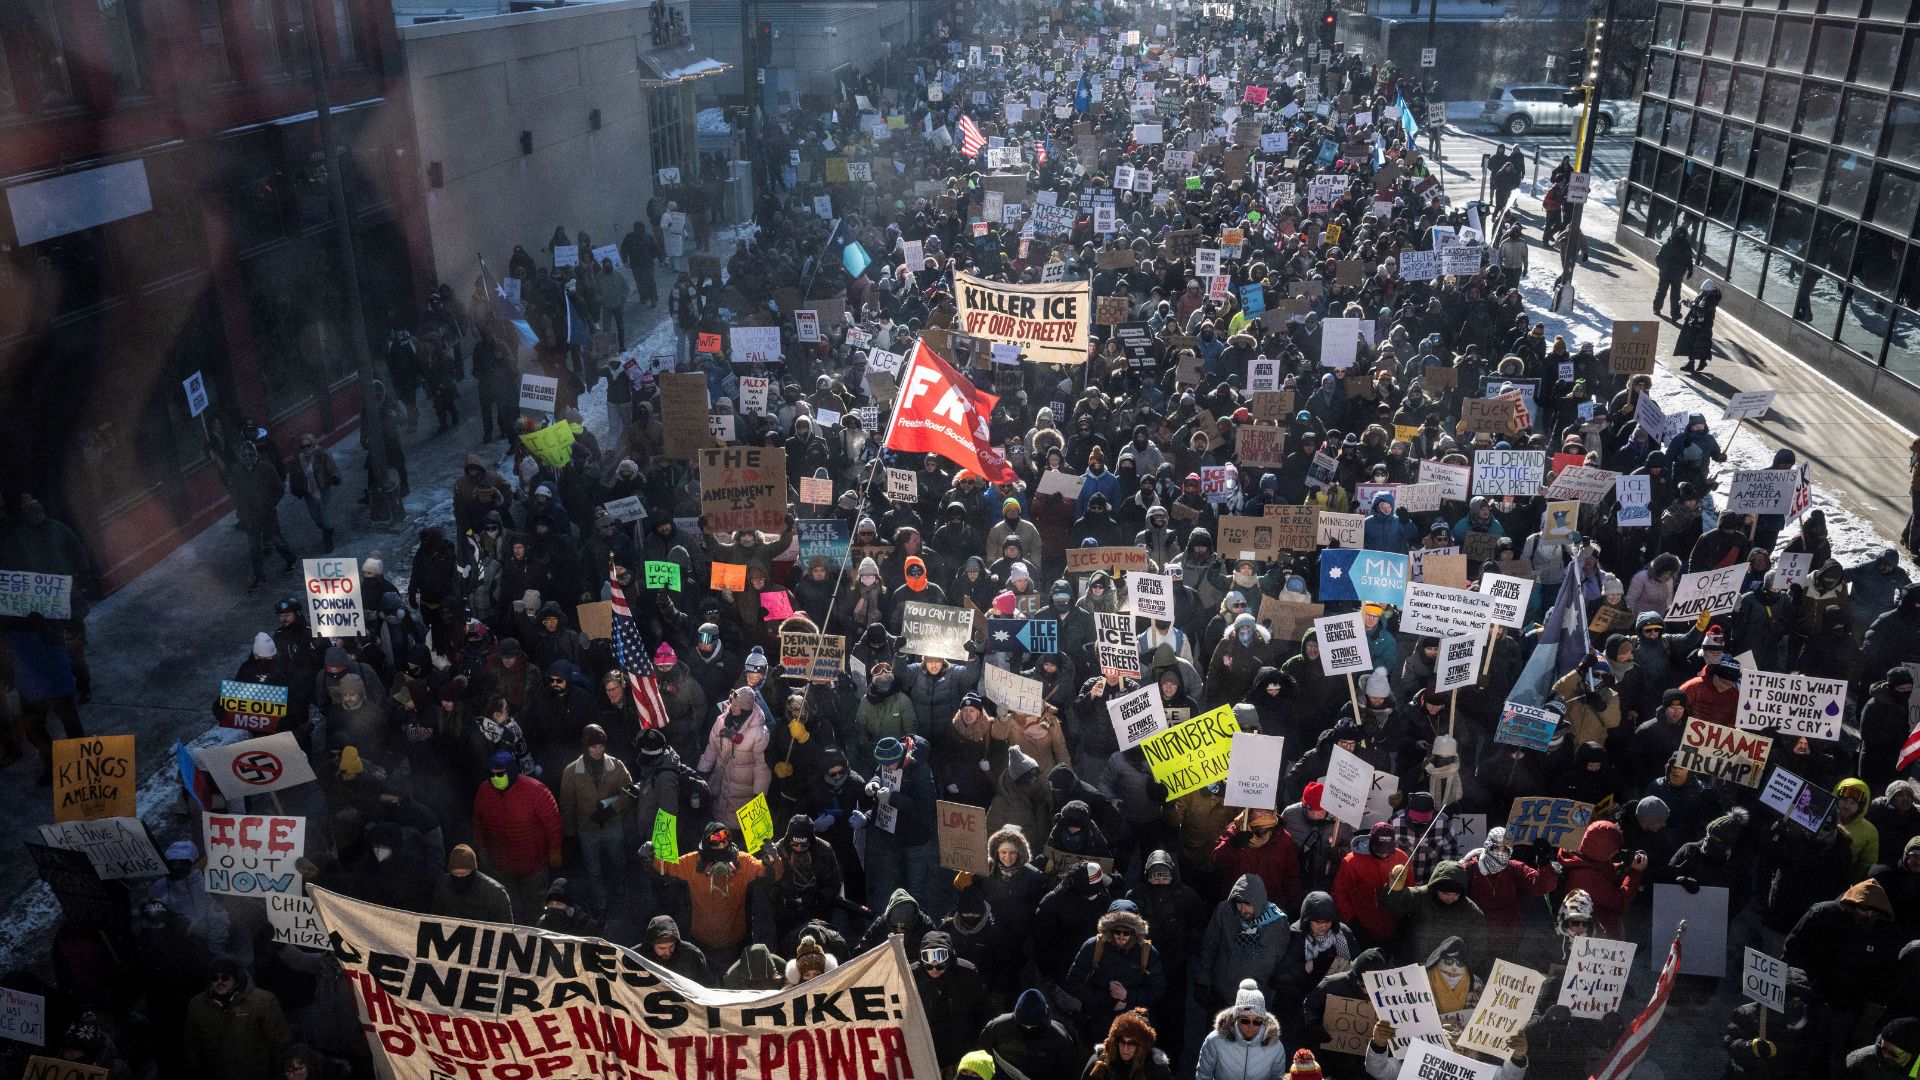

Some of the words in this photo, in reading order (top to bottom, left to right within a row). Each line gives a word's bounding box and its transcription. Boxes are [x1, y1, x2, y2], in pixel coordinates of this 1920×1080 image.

[849, 163, 867, 171] FUCK
[1036, 203, 1060, 215] THIS
[1061, 209, 1075, 219] IS
[1403, 252, 1443, 263] BELIEVE
[1046, 264, 1063, 276] ICE
[965, 287, 1036, 319] KILLER
[1043, 297, 1077, 319] ICE
[967, 312, 988, 334] OFF
[989, 313, 1016, 337] OUR
[1017, 320, 1077, 343] STREETS!
[700, 336, 719, 347] WTF
[848, 331, 869, 339] MELT
[746, 352, 768, 362] FALL
[1614, 357, 1646, 370] GOOD
[1257, 393, 1287, 402] FUCK
[1264, 405, 1287, 416] ICE
[1470, 402, 1509, 416] FUCK
[924, 419, 945, 432] Road
[1473, 420, 1501, 430] ICE
[704, 450, 761, 468] THE
[1477, 452, 1495, 465] WE
[1502, 452, 1544, 467] DEMAND
[891, 471, 913, 482] FUCK
[1203, 469, 1225, 481] ICE
[1480, 467, 1529, 480] JUSTICE
[1734, 472, 1798, 483] IMMIGRANTS
[895, 482, 910, 492] THE
[1203, 481, 1226, 493] OUT
[1474, 480, 1504, 494] ALEX
[1623, 480, 1646, 491] ICE
[1748, 482, 1775, 491] MAKE
[703, 485, 775, 501] AMENDMENT
[888, 491, 917, 502] GESTAPO
[1620, 492, 1646, 502] OUT
[1735, 490, 1781, 500] AMERICA
[731, 497, 756, 510] IS
[1265, 506, 1289, 515] ICE
[1296, 506, 1312, 514] IS
[1320, 517, 1363, 528] MINNESOTA
[1071, 553, 1097, 567] ICE
[1102, 552, 1122, 561] OUT
[318, 562, 344, 578] ICE
[649, 565, 671, 573] FUCK
[1365, 559, 1403, 578] MN
[35, 575, 64, 587] OUT
[308, 578, 353, 593] GTFO
[649, 576, 672, 585] ICE
[1139, 578, 1162, 587] JUSTICE
[1360, 576, 1402, 590] STRONG
[1493, 580, 1520, 590] JUSTICE
[1698, 570, 1734, 589] OPE
[35, 586, 63, 595] OUT
[1137, 585, 1149, 593] FOR
[1490, 588, 1503, 597] FOR
[1504, 591, 1520, 600] ALEX
[313, 599, 356, 609] DONCHA
[1671, 591, 1736, 616] MURDER
[317, 613, 359, 627] KNOW?
[906, 605, 926, 616] YOU
[929, 608, 955, 620] CAN'T
[959, 611, 970, 623] BE
[1030, 621, 1056, 635] ICE
[1100, 614, 1130, 631] KILLER
[1324, 623, 1343, 632] EXPAND
[1344, 620, 1354, 628] THE
[1470, 621, 1486, 629] MOST
[784, 635, 818, 646] DETAIN
[824, 638, 838, 646] THE
[1099, 629, 1135, 646] ICE
[1326, 629, 1356, 642] GENERAL
[1030, 636, 1057, 653] OUT
[1101, 646, 1116, 654] OFF
[1449, 641, 1465, 651] EXPAND
[783, 646, 809, 657] REAL
[1331, 646, 1358, 659] STRIKE!
[1448, 648, 1473, 661] GENERAL
[783, 657, 809, 666] TRUMP
[1102, 653, 1138, 670] STREETS
[1448, 663, 1470, 676] STRIKE!
[992, 669, 1014, 688] DHS
[1791, 680, 1801, 691] IS
[1807, 681, 1843, 695] WHAT
[1017, 696, 1038, 713] ICE
[1120, 696, 1138, 712] EXPAND
[1139, 691, 1150, 702] THE
[1750, 689, 1762, 699] IT
[1767, 691, 1816, 707] SOUNDS
[222, 698, 246, 712] ICE
[251, 701, 285, 715] OUT
[1122, 700, 1151, 720] GENERAL
[1509, 704, 1522, 714] TO
[1758, 702, 1782, 714] LIKE
[1789, 706, 1822, 719] WHEN
[234, 715, 270, 728] MSP
[1128, 715, 1154, 734] STRIKE!
[1749, 713, 1792, 729] DOVES
[1687, 721, 1768, 762] SHAME
[80, 741, 103, 758] NO
[59, 758, 128, 787] KINGS
[1777, 773, 1787, 781] Hey
[1160, 766, 1201, 794] NAZIS
[62, 786, 118, 808] AMERICA
[1769, 785, 1792, 799] message
[1520, 800, 1574, 824] ICE
[942, 809, 976, 833] LOVE
[50, 825, 73, 844] WE
[210, 817, 296, 854] ICE
[120, 859, 158, 874] KING
[220, 856, 281, 872] OUT
[210, 869, 294, 892] NOW
[295, 917, 318, 930] LA
[1752, 953, 1778, 979] ICE
[405, 1006, 572, 1061] PEOPLE
[668, 1035, 748, 1080] THE
[760, 1028, 914, 1080] POWER
[1423, 1053, 1458, 1074] EXPAND
[1459, 1067, 1476, 1080] THE
